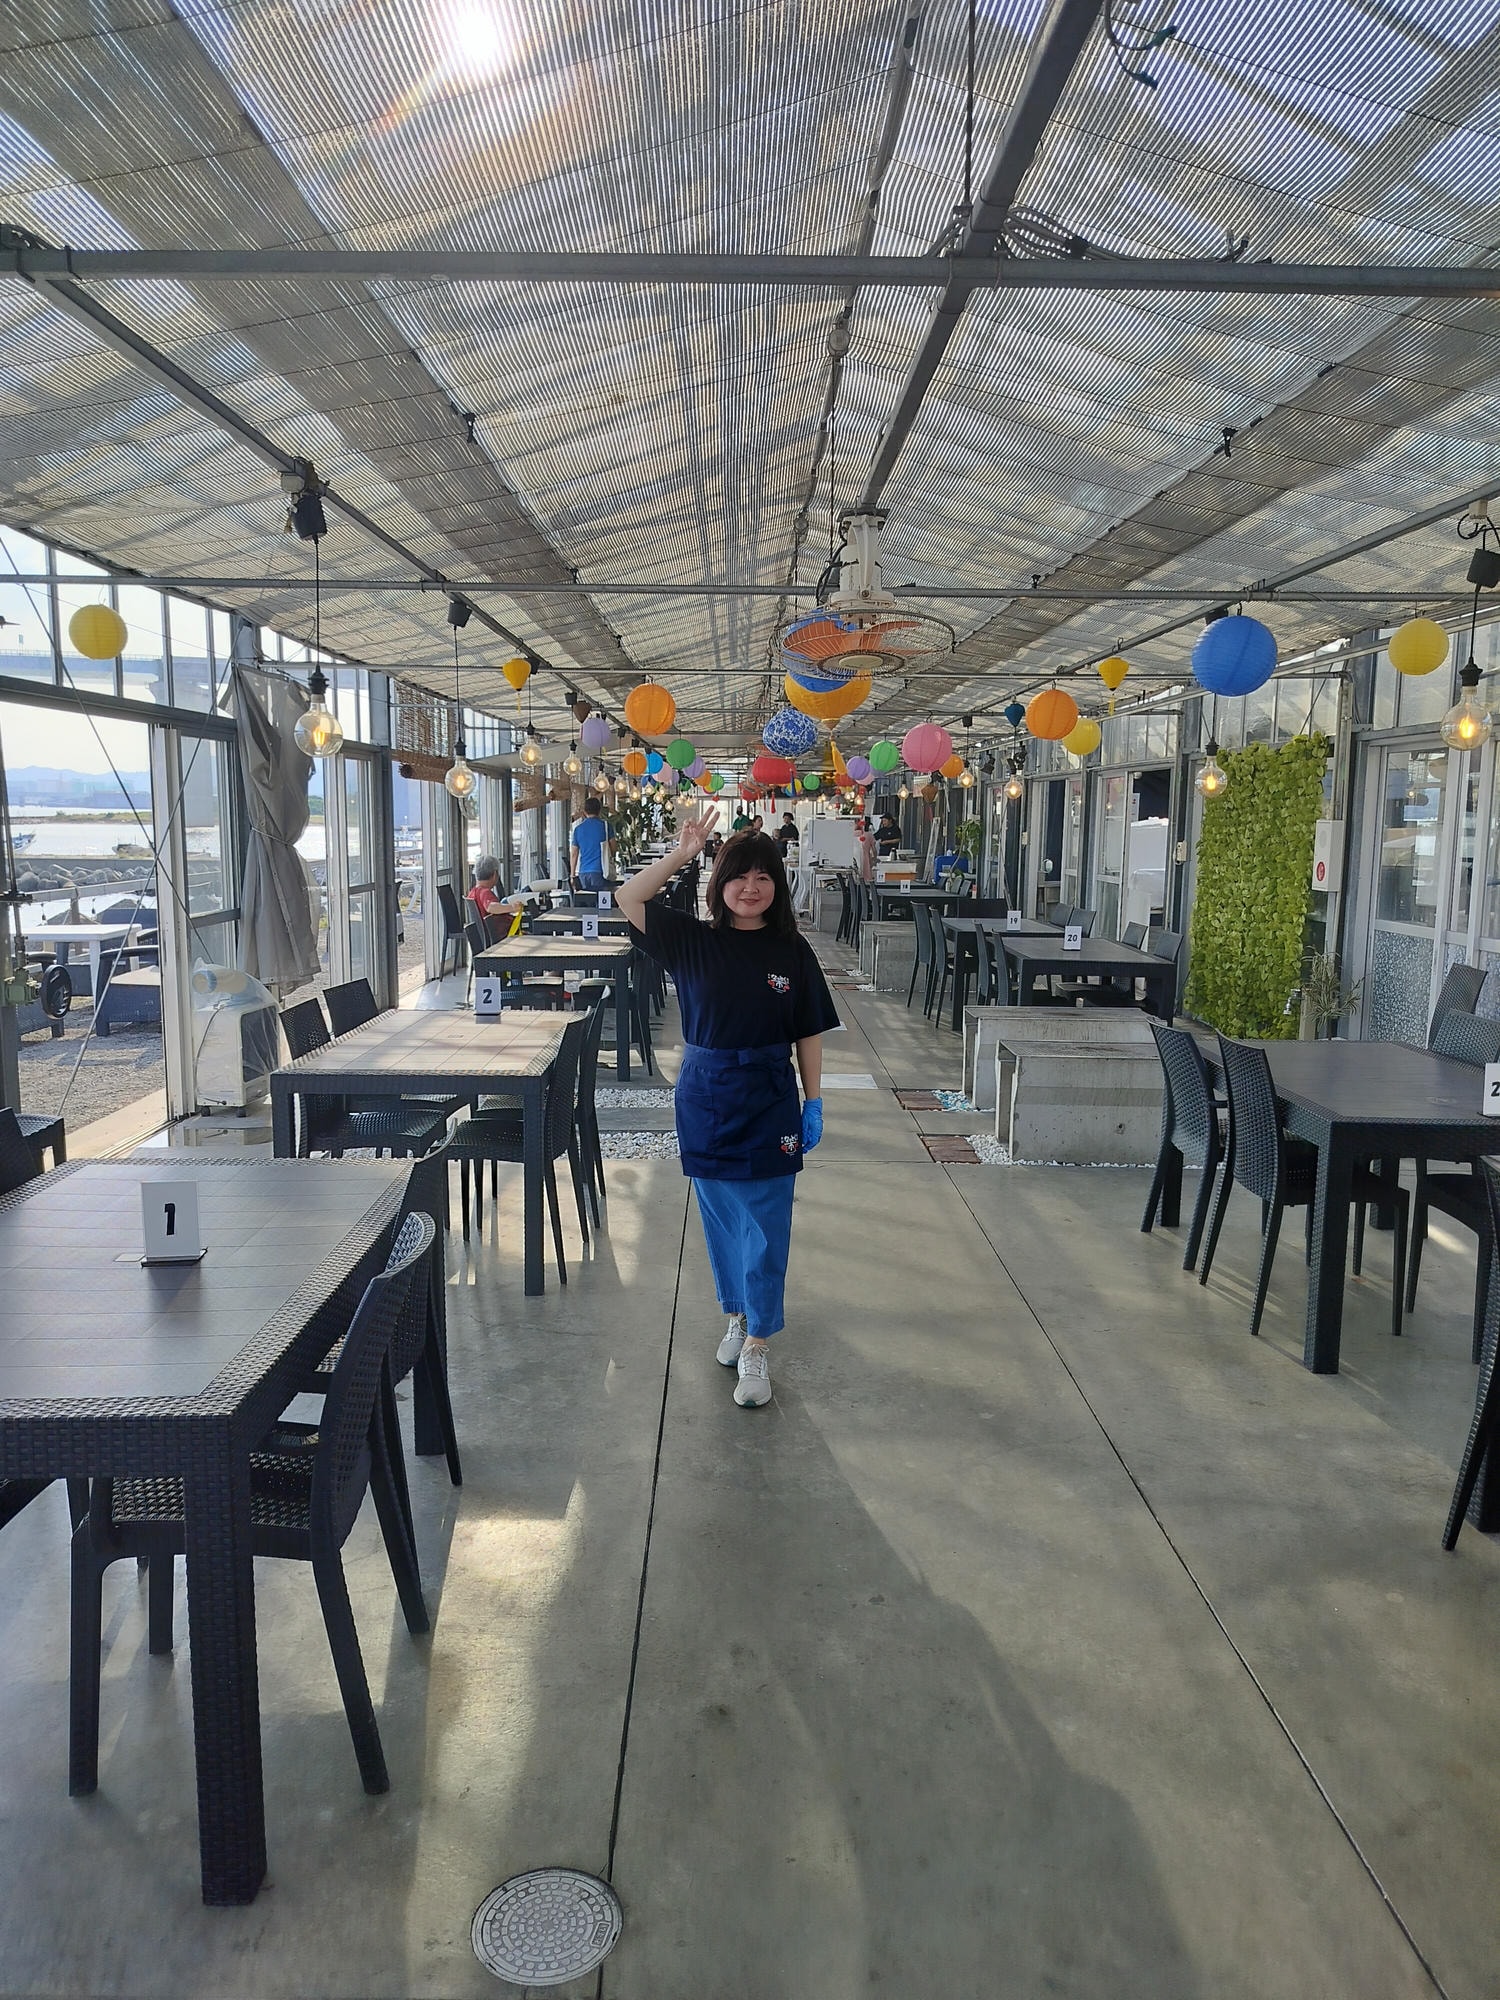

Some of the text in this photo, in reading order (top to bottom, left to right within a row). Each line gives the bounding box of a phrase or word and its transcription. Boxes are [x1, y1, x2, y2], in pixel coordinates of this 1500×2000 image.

[586, 921, 593, 931] 5
[1067, 934, 1078, 942] 20
[482, 988, 493, 1004] 2
[164, 1202, 176, 1236] 1
